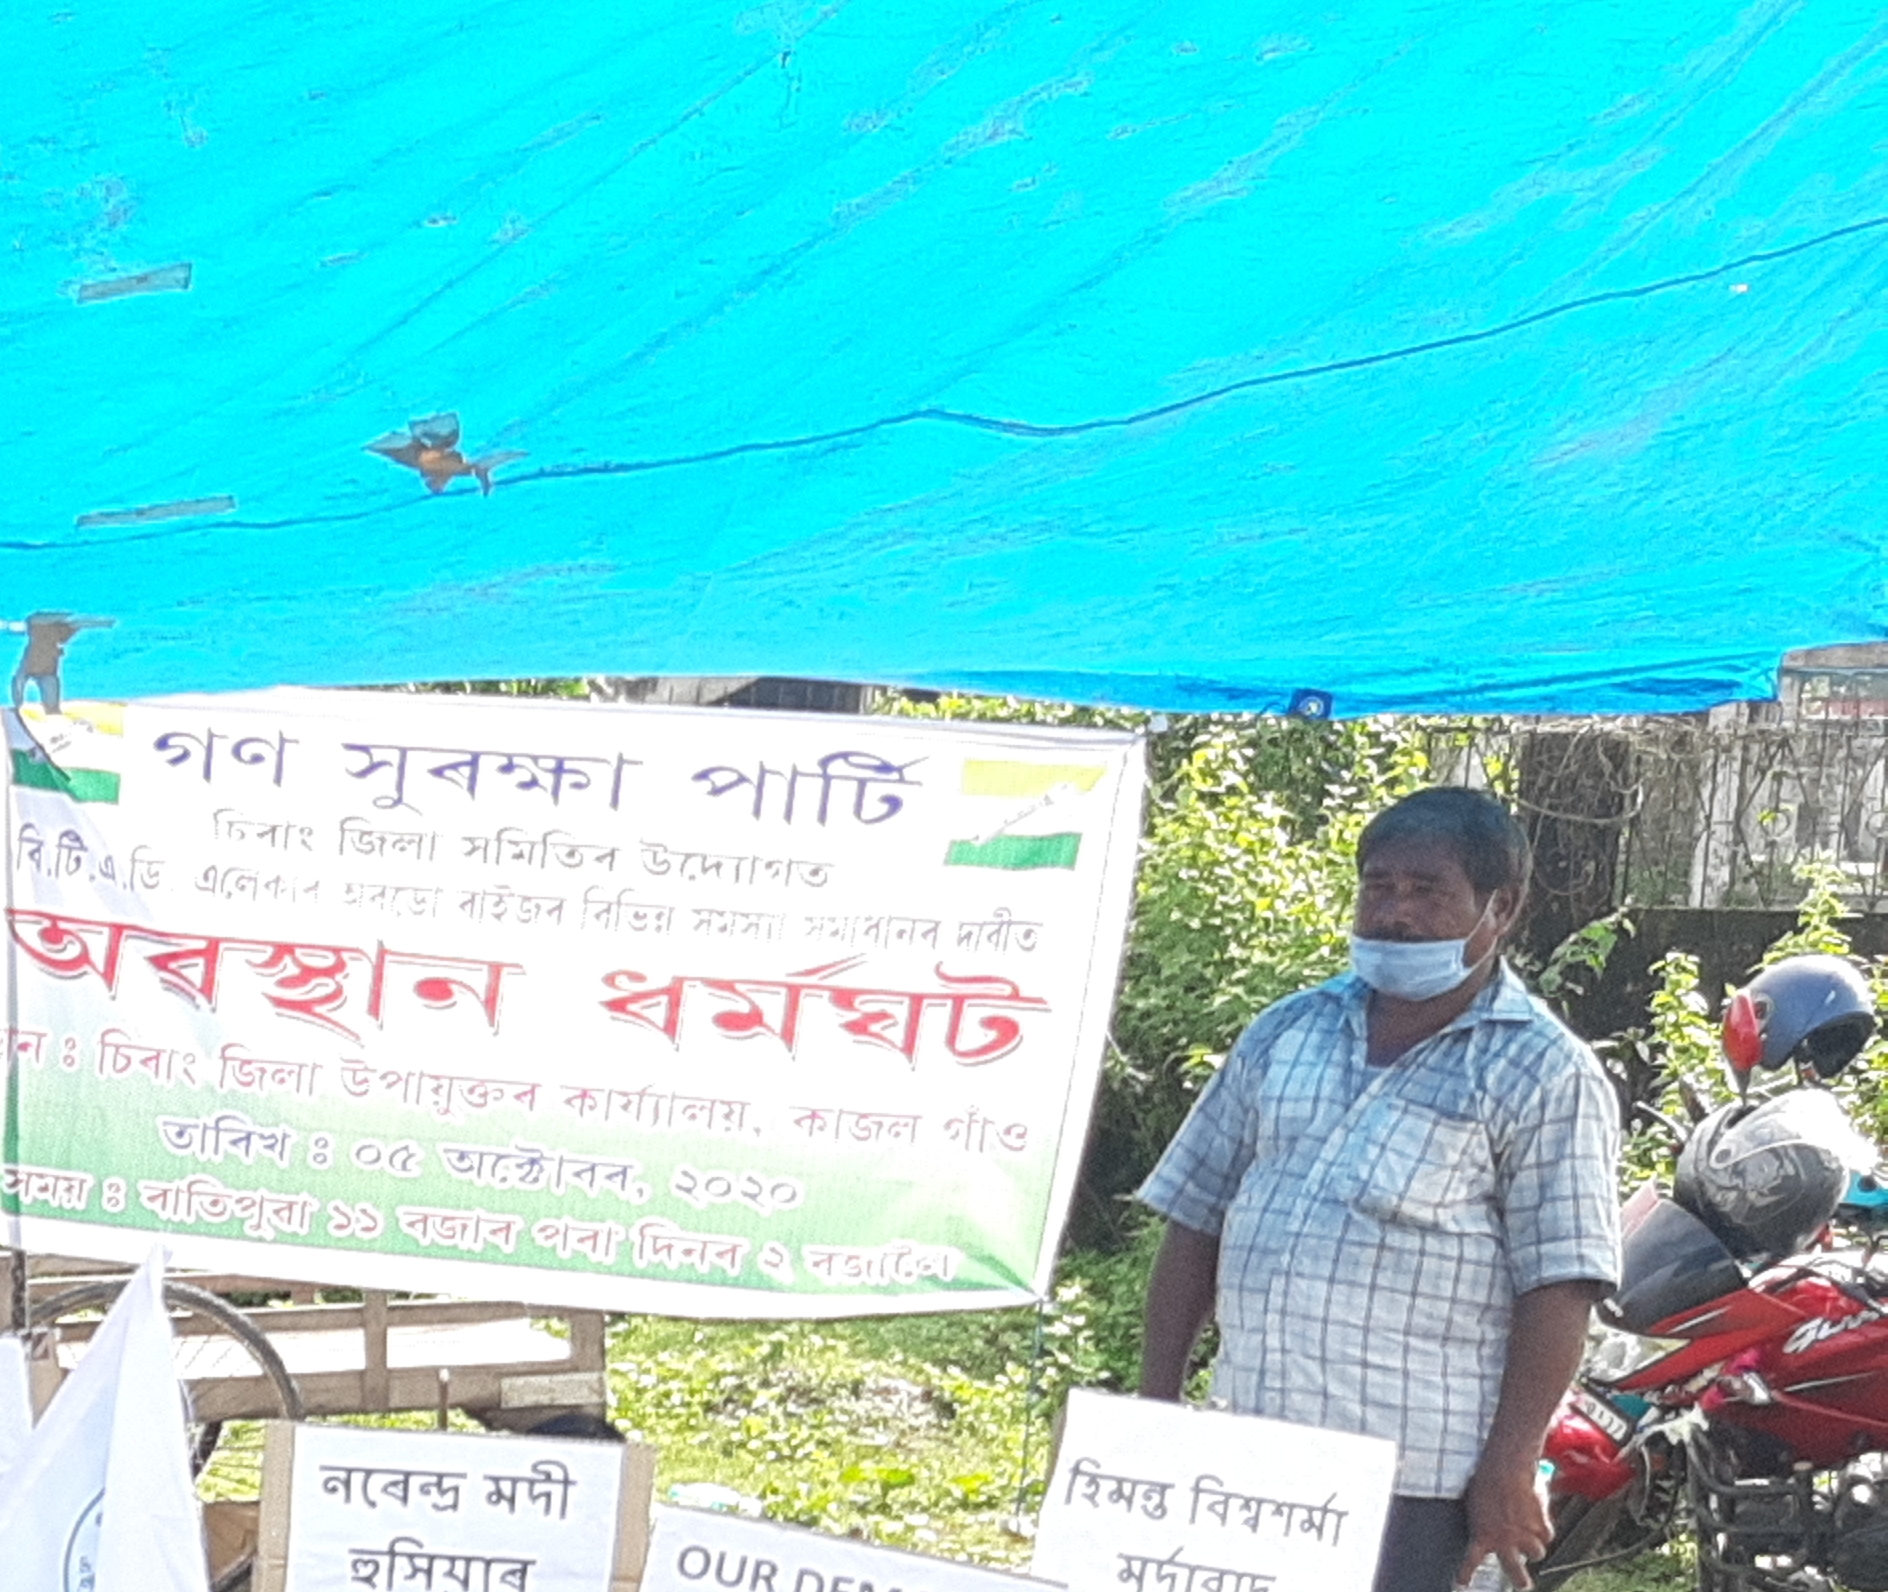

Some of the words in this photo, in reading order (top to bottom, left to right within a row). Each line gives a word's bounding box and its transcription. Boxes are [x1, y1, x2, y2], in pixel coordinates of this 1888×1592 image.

[154, 727, 299, 787] গণ
[339, 816, 443, 863] জিলা
[5, 907, 526, 1048] অবস্থান
[219, 1043, 323, 1098] জিলা
[789, 1105, 922, 1146] কাজল
[943, 1104, 1028, 1154] গাঁও
[355, 1142, 419, 1174] ০৫
[674, 1168, 799, 1206] ২০২০
[330, 1205, 381, 1234] ১১
[483, 1459, 578, 1521] মদী
